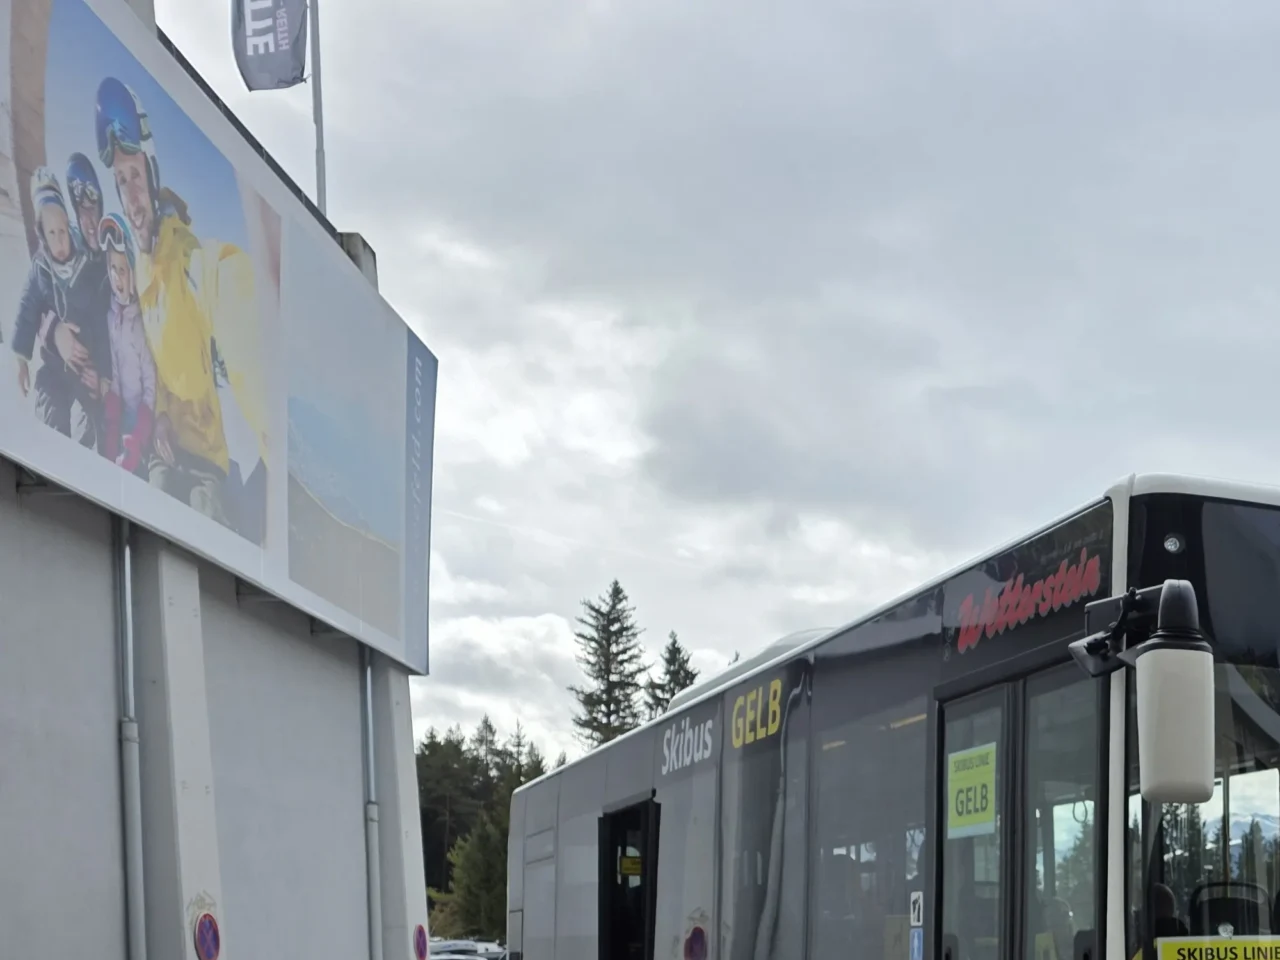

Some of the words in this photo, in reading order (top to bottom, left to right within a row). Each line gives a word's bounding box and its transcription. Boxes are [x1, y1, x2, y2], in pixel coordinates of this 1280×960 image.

[661, 717, 713, 776] Skibus
[731, 678, 782, 749] GELB
[955, 783, 989, 817] GELB
